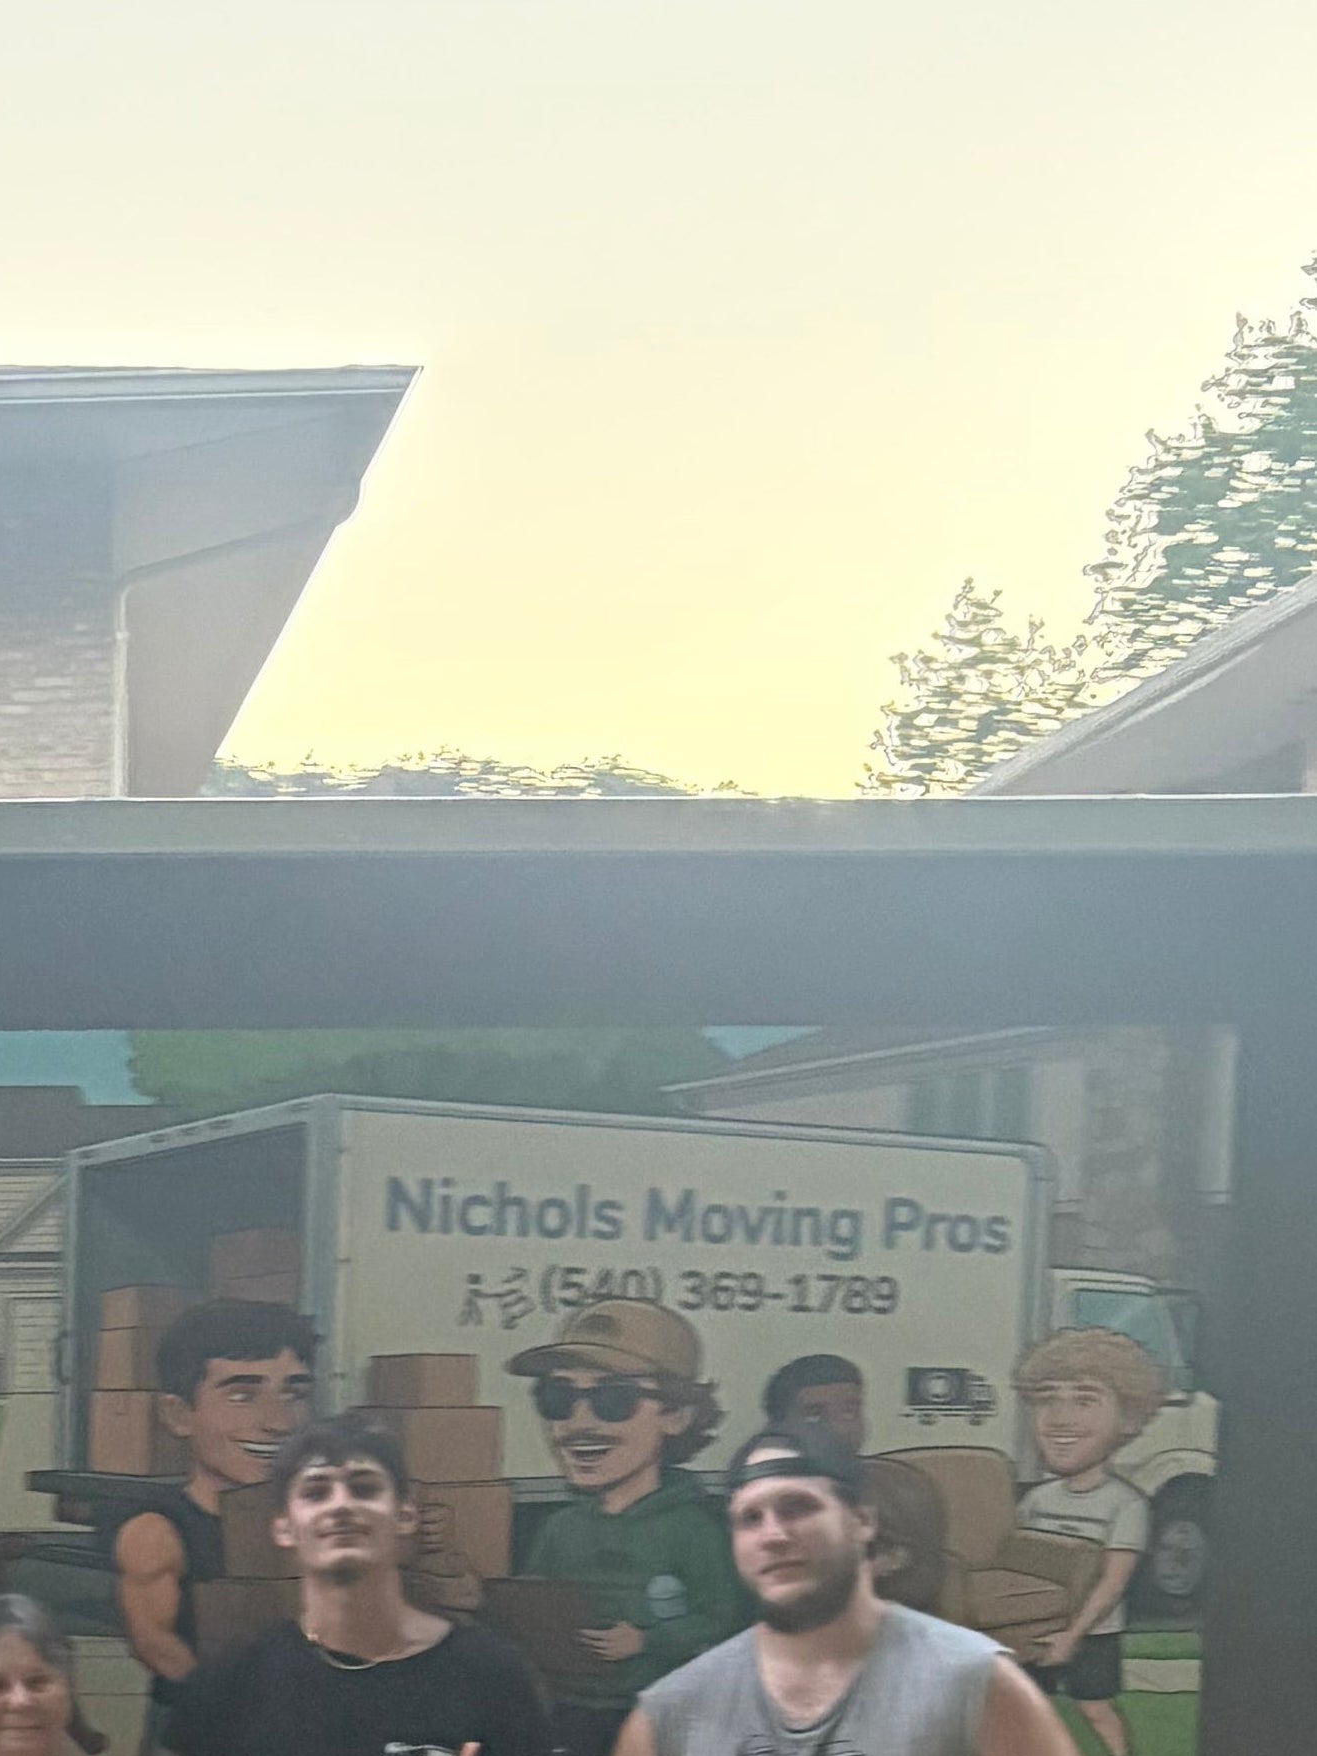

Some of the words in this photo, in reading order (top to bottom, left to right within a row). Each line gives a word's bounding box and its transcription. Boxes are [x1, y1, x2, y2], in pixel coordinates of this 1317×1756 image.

[385, 1176, 624, 1240] Nichols
[644, 1186, 862, 1262] Moving
[883, 1196, 1011, 1254] Pros
[678, 1269, 901, 1315] 369-1789
